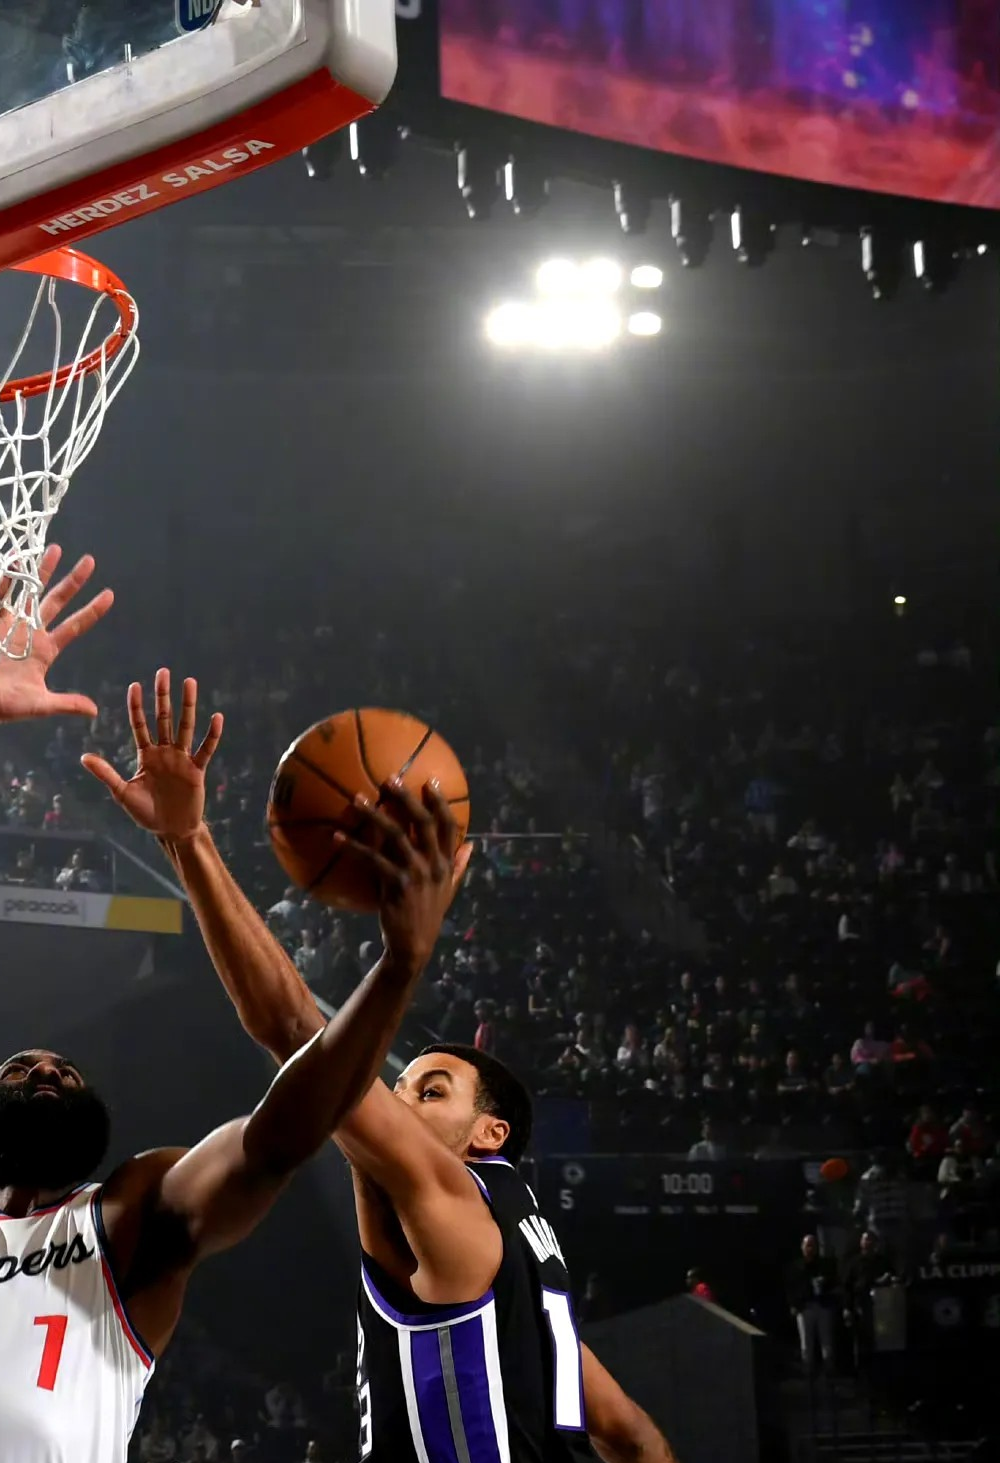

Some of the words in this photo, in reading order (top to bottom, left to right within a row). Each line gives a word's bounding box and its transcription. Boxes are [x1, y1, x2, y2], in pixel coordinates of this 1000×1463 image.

[38, 182, 161, 237] HERDEZ
[161, 137, 275, 189] SALSA
[3, 896, 80, 918] peacock
[661, 1173, 713, 1195] 10:00
[560, 1189, 575, 1210] 5
[33, 1314, 69, 1392] 1
